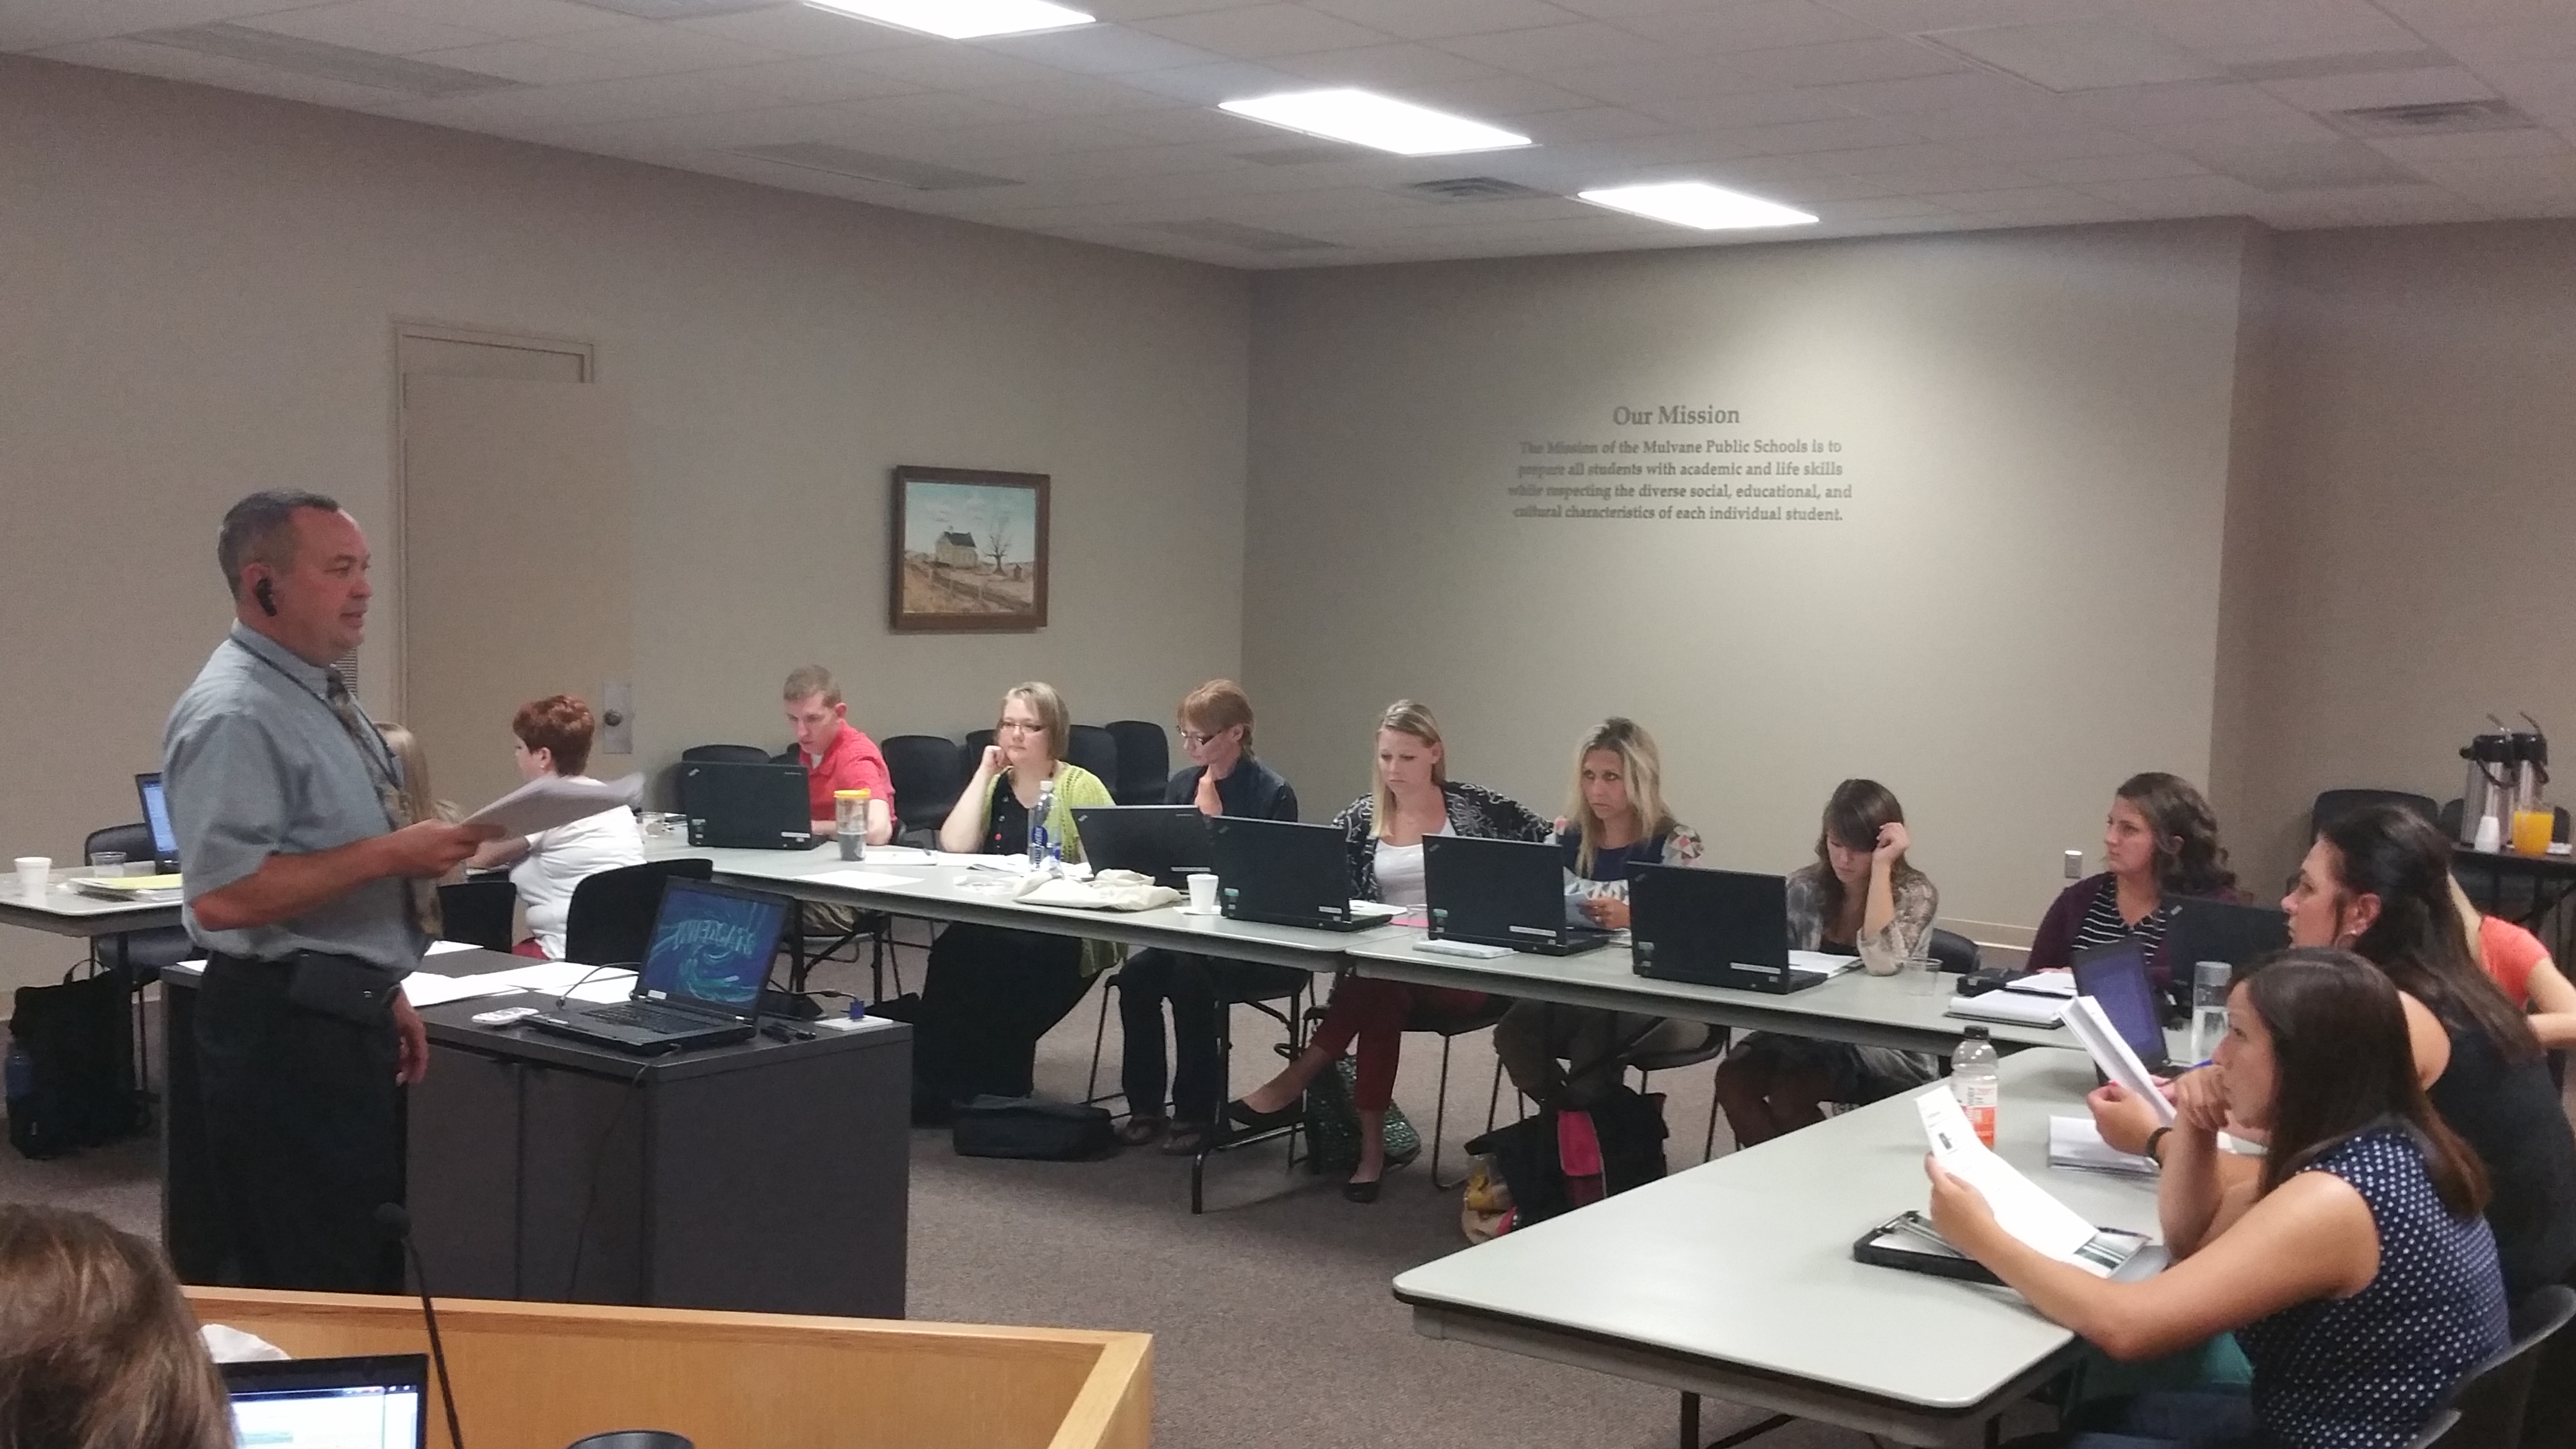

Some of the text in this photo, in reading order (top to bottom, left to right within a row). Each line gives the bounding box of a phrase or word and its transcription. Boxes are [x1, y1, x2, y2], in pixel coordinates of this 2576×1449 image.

[1613, 405, 1740, 425] Our Mission
[1519, 439, 1842, 453] The Mission of the Mulvane Public Schools is to
[1567, 463, 1585, 475] all
[1587, 463, 1642, 475] students
[1646, 463, 1676, 475] with
[1680, 462, 1742, 475] academic
[1746, 462, 1772, 475] and
[1775, 462, 1800, 475] life
[1803, 462, 1843, 475] skills
[1546, 484, 1611, 500] respecting
[1615, 484, 1635, 497] the
[1639, 484, 1687, 497] diverse
[1690, 484, 1732, 499] social,
[1736, 484, 1821, 499] educational,
[1825, 484, 1852, 498] and
[1565, 505, 1655, 518] characteristics
[1658, 506, 1673, 518] of
[1676, 506, 1706, 519] each
[1710, 506, 1781, 520] individual
[1786, 507, 1843, 521] student.
